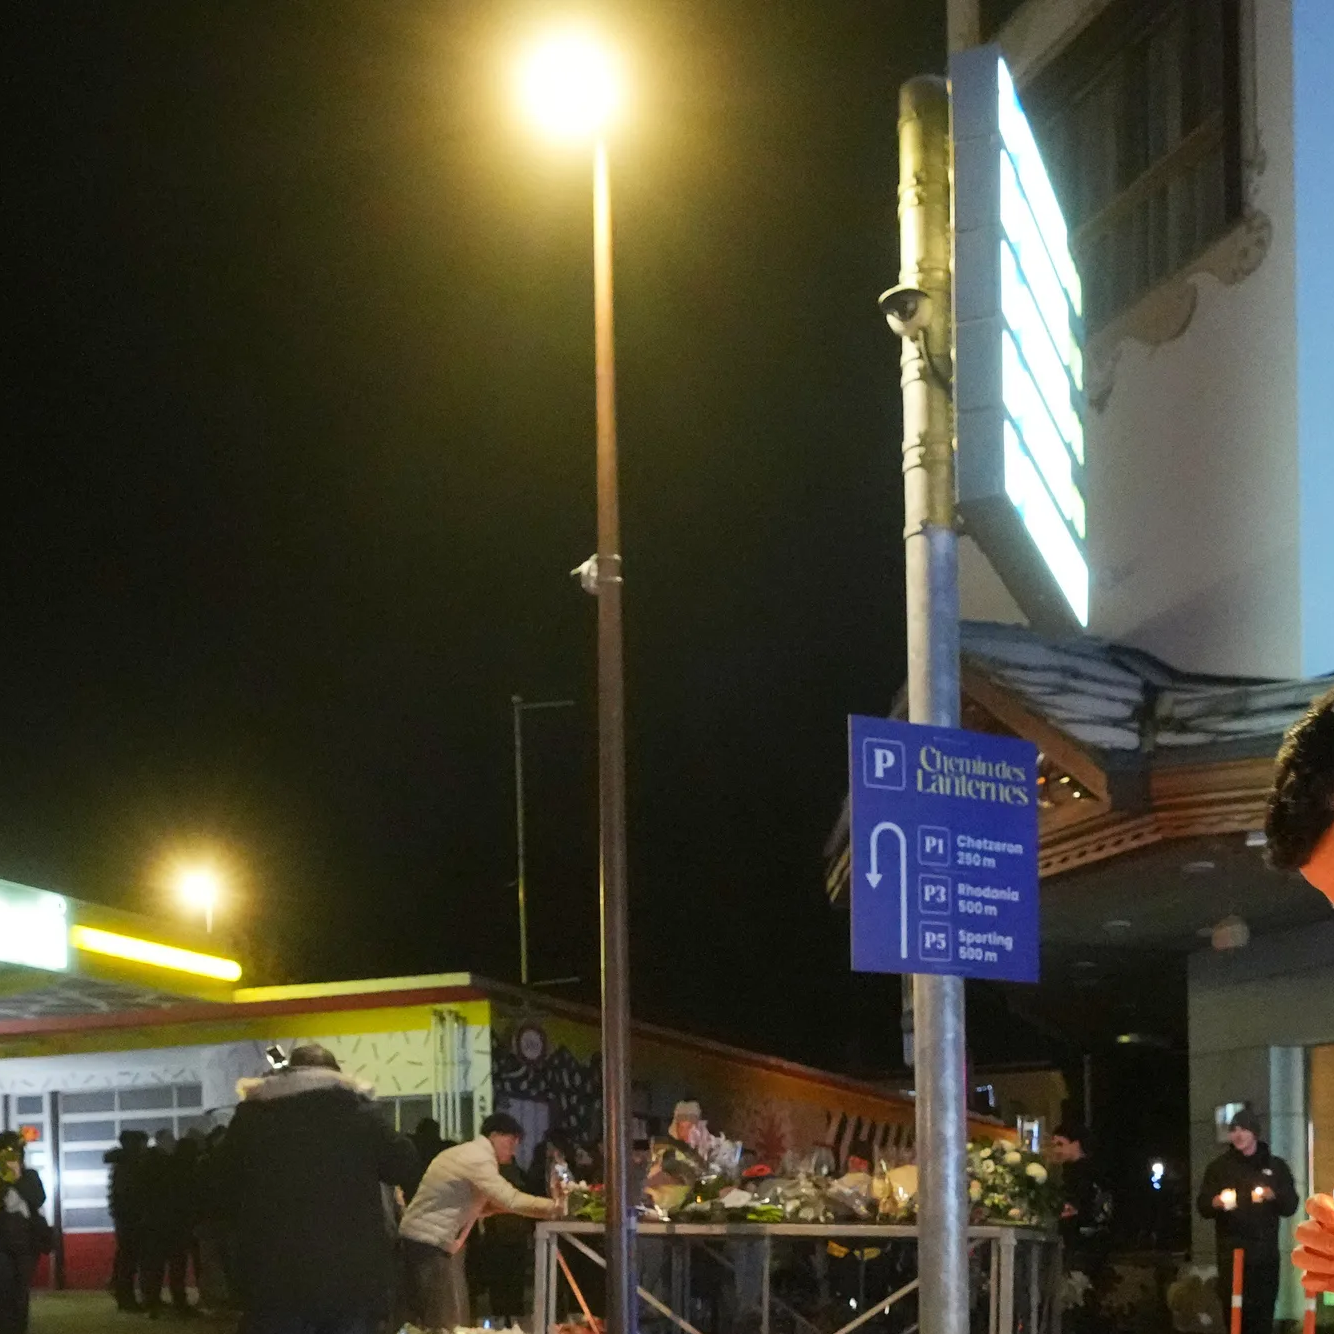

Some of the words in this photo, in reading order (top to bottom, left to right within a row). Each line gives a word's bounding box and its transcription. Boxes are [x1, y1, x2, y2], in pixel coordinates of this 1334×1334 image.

[874, 748, 896, 778] P
[919, 745, 994, 778] Chemin
[995, 760, 1027, 782] des
[917, 767, 1029, 806] Lanternes
[924, 836, 944, 854] P1
[924, 884, 946, 903] P3
[958, 883, 1020, 902] Rhodania
[924, 931, 946, 950] P5
[958, 929, 1013, 952] Sporting
